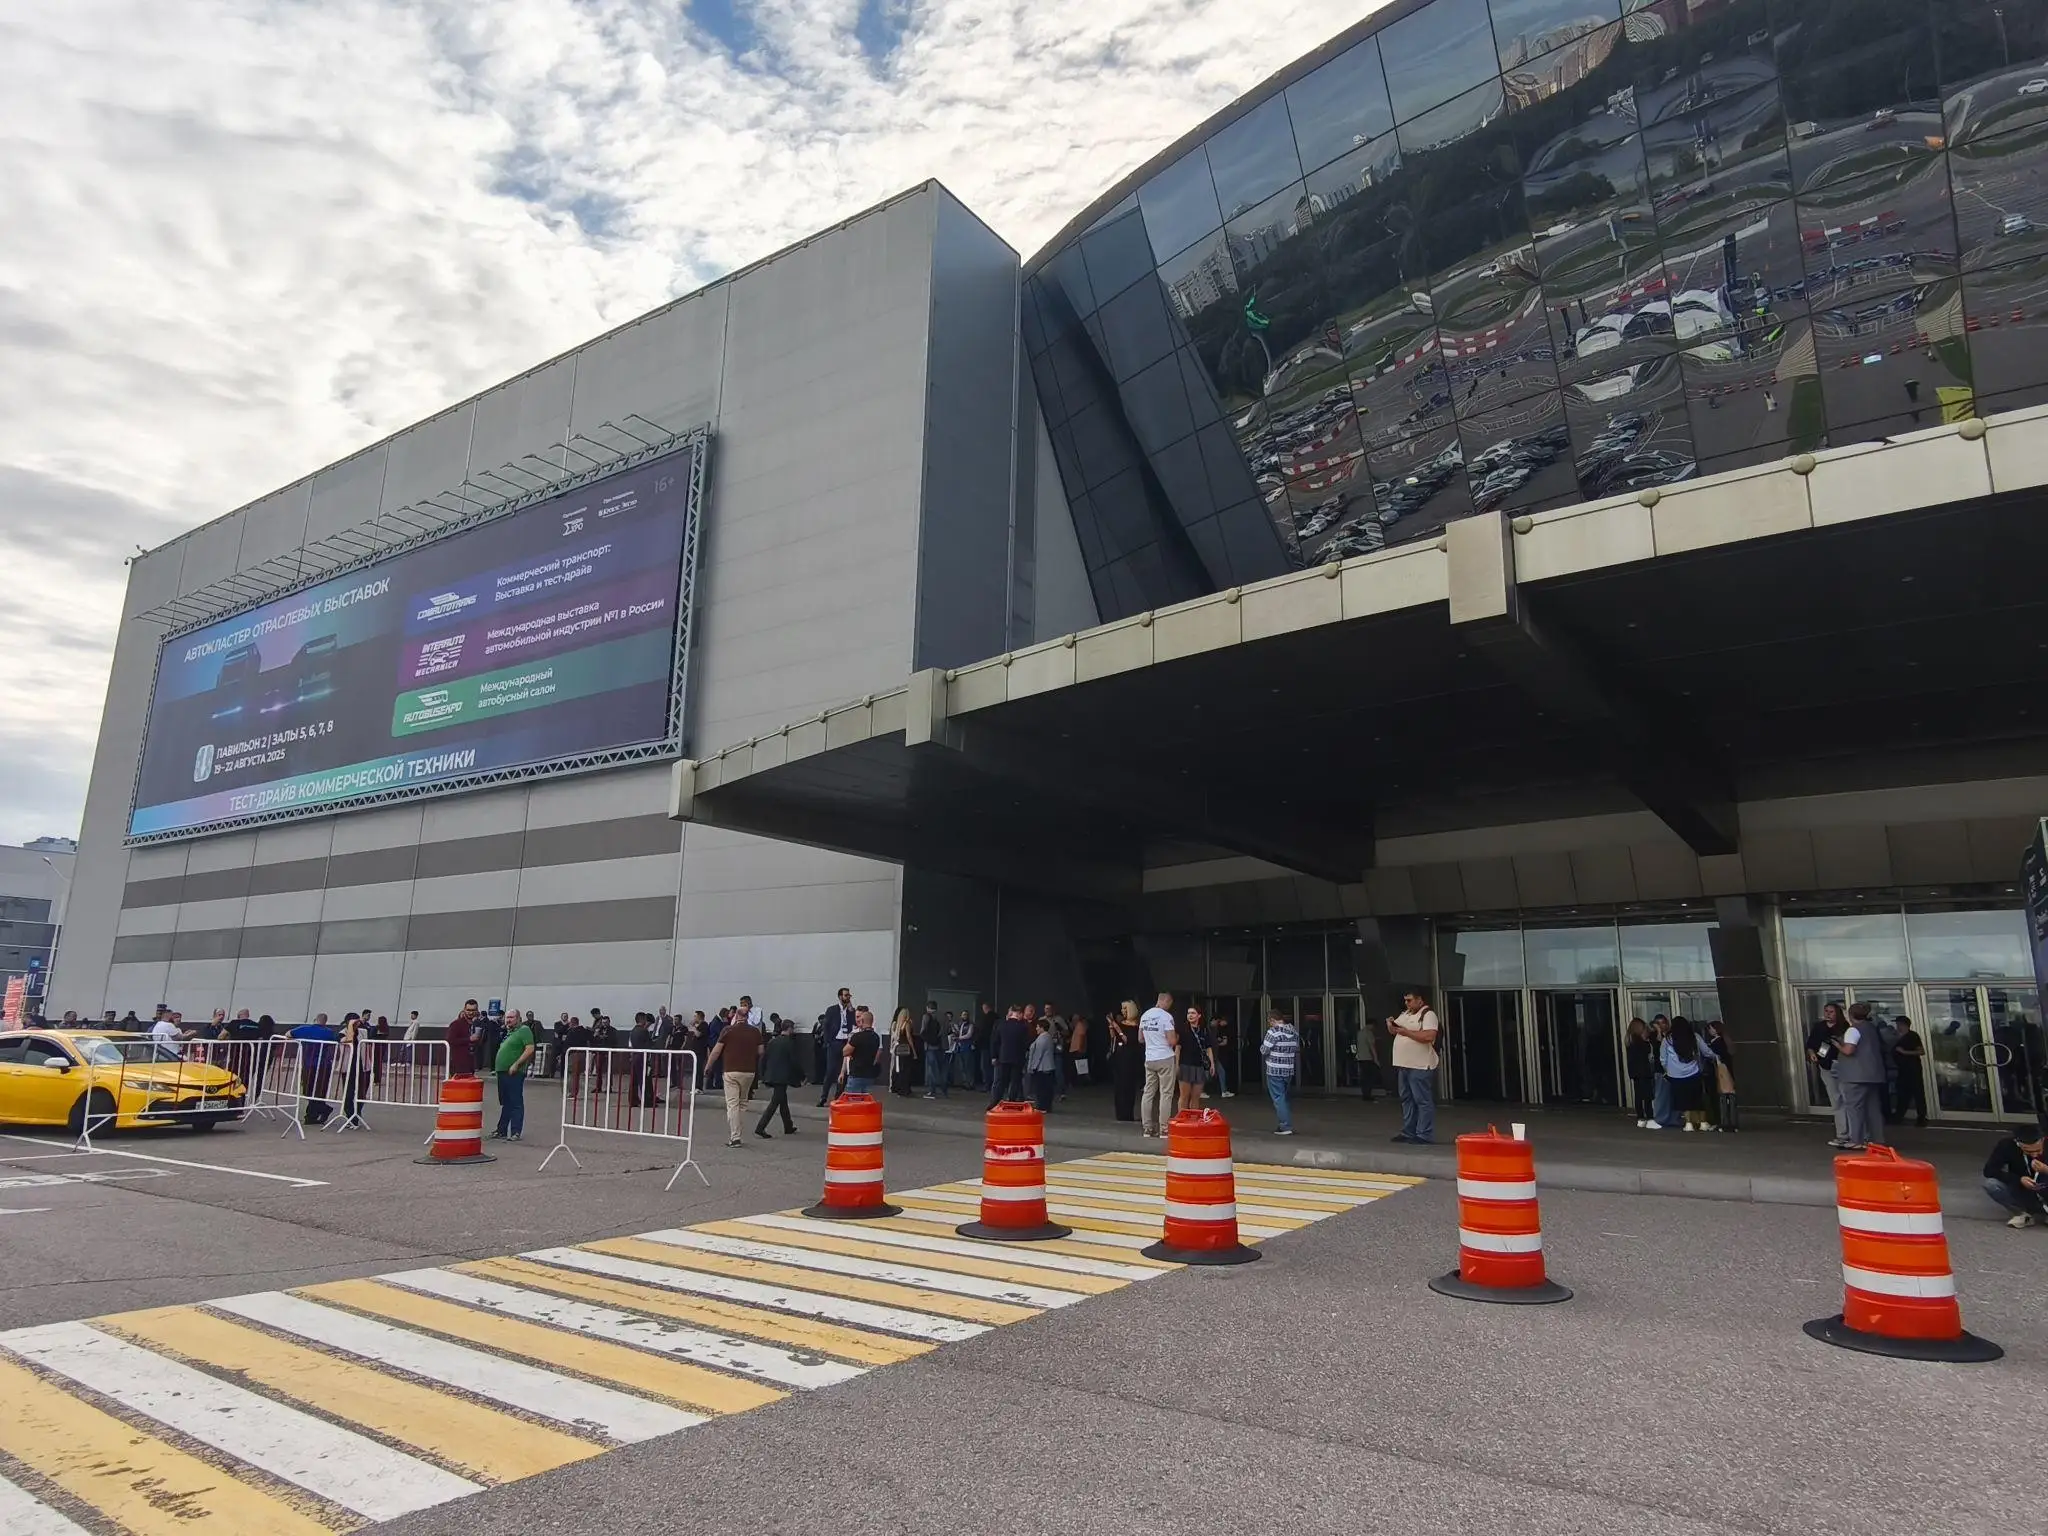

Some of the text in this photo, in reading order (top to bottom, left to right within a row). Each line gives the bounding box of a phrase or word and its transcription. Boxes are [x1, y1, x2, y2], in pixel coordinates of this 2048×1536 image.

[494, 564, 592, 602] Выставка и тест-драйв
[497, 544, 611, 587] Коммерческий транспорт:
[184, 576, 390, 663] АВТОКЛАСТЕР ОТРАСЛЕВЫХ ВЫСТАВОК
[485, 599, 665, 655] автомобильной индустрии №1 в России
[487, 614, 556, 640] Международная
[558, 601, 600, 622] выставка
[422, 634, 466, 654] INTERAUTO
[478, 684, 556, 708] автобусный салон
[480, 667, 553, 693] Международный
[403, 701, 463, 723] AUTOBUSEXPO
[216, 738, 260, 760] ПАВИЛЬОН
[261, 738, 267, 749] 2
[272, 728, 299, 746] ЗАЛЫ
[299, 727, 307, 741] 5,
[309, 724, 317, 738] 6,
[318, 722, 326, 735] 7,
[327, 720, 334, 732] 8
[234, 754, 266, 770] АВГУСТА
[267, 748, 286, 763] 2025
[229, 748, 476, 811] ТЕСТ-ДРАЙВ КОММЕРЧЕСКОЙ ТЕХНИКИ
